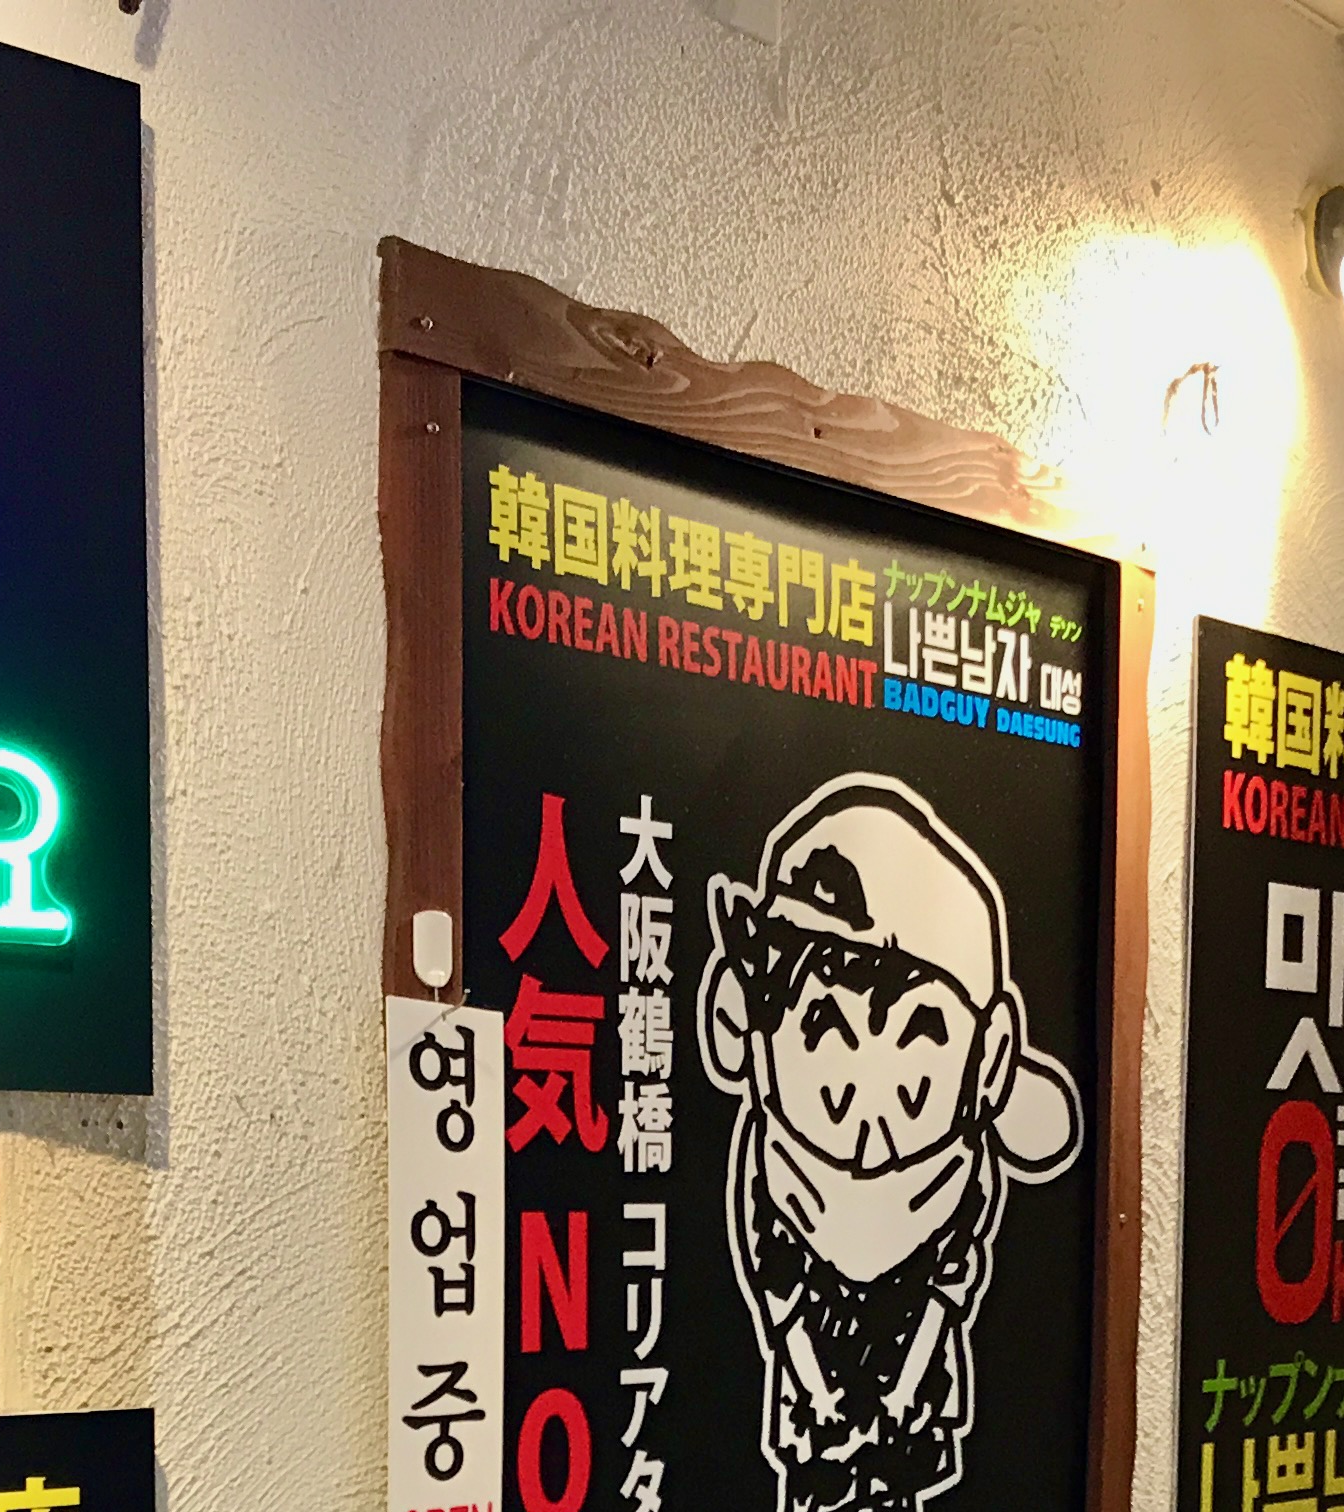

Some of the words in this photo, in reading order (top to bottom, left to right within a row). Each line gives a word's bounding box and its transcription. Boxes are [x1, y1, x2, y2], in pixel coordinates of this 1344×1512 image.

[488, 464, 877, 647] 韓国料理専門店
[883, 559, 1042, 634] ナップンナムジャ
[489, 577, 648, 663] KOREAN
[659, 613, 877, 709] RESTAURANT
[884, 600, 1033, 704] 나쁜남자
[1040, 662, 1082, 716] 대성
[883, 677, 991, 729] BADGUY
[996, 706, 1081, 748] DAESUNG
[617, 795, 674, 1173] 大阪鶴橋
